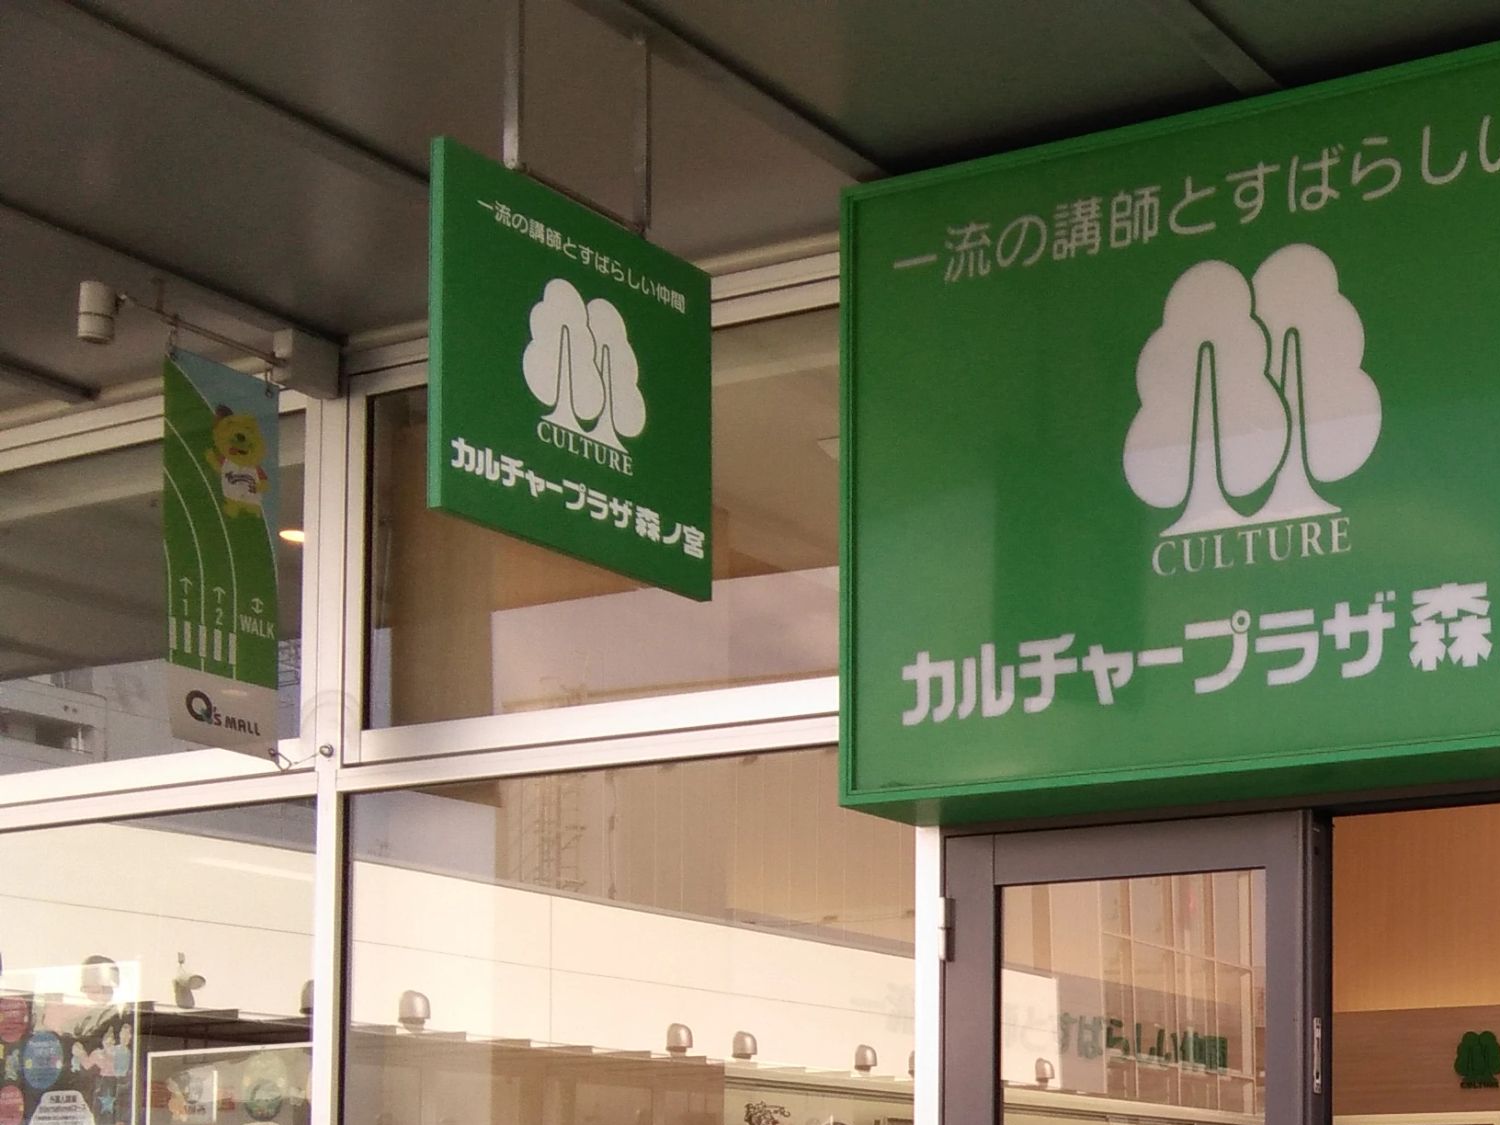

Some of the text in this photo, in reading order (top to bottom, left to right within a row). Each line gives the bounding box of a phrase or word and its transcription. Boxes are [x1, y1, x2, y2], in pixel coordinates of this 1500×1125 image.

[477, 200, 687, 314] 一流の講師とすばらしい仲間
[537, 420, 634, 477] CULTURE
[450, 436, 706, 560] カルチャープラザ森ノ宮
[1151, 517, 1353, 577] CULTURE
[239, 612, 276, 640] WALK
[224, 716, 261, 737] MALL
